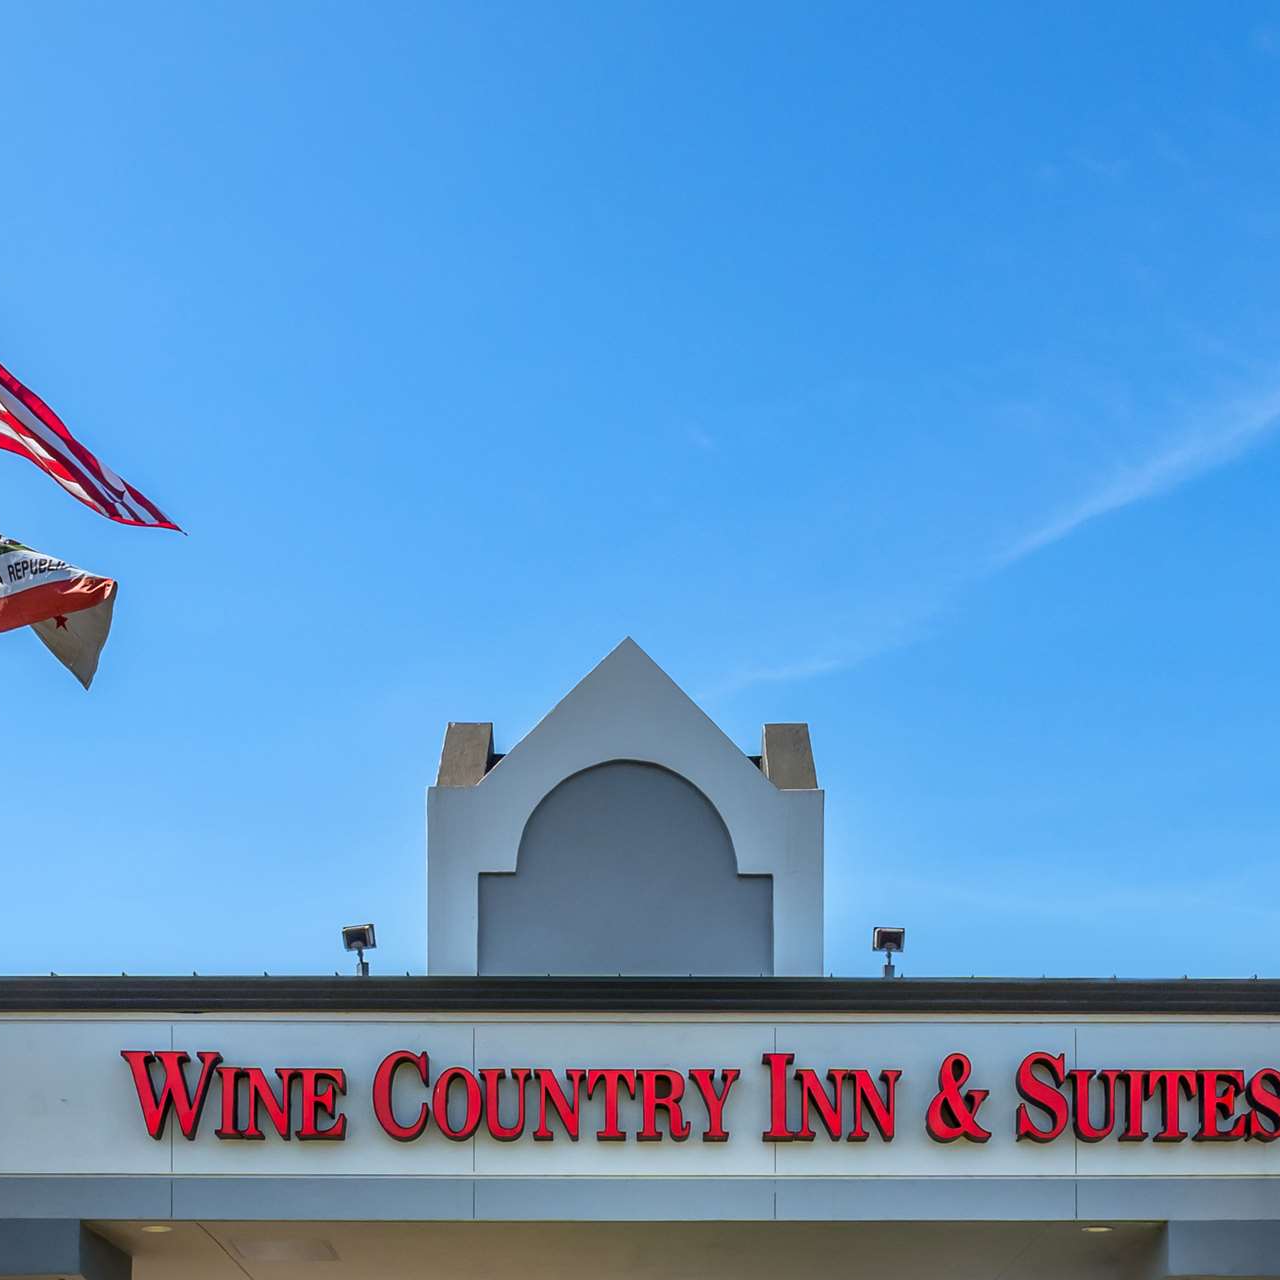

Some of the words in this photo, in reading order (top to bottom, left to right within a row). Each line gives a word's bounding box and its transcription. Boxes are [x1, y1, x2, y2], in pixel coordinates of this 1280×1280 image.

[120, 1050, 347, 1141] WINE
[372, 1050, 741, 1142] COUNTRY
[761, 1053, 902, 1142] INN
[926, 1053, 992, 1143] &
